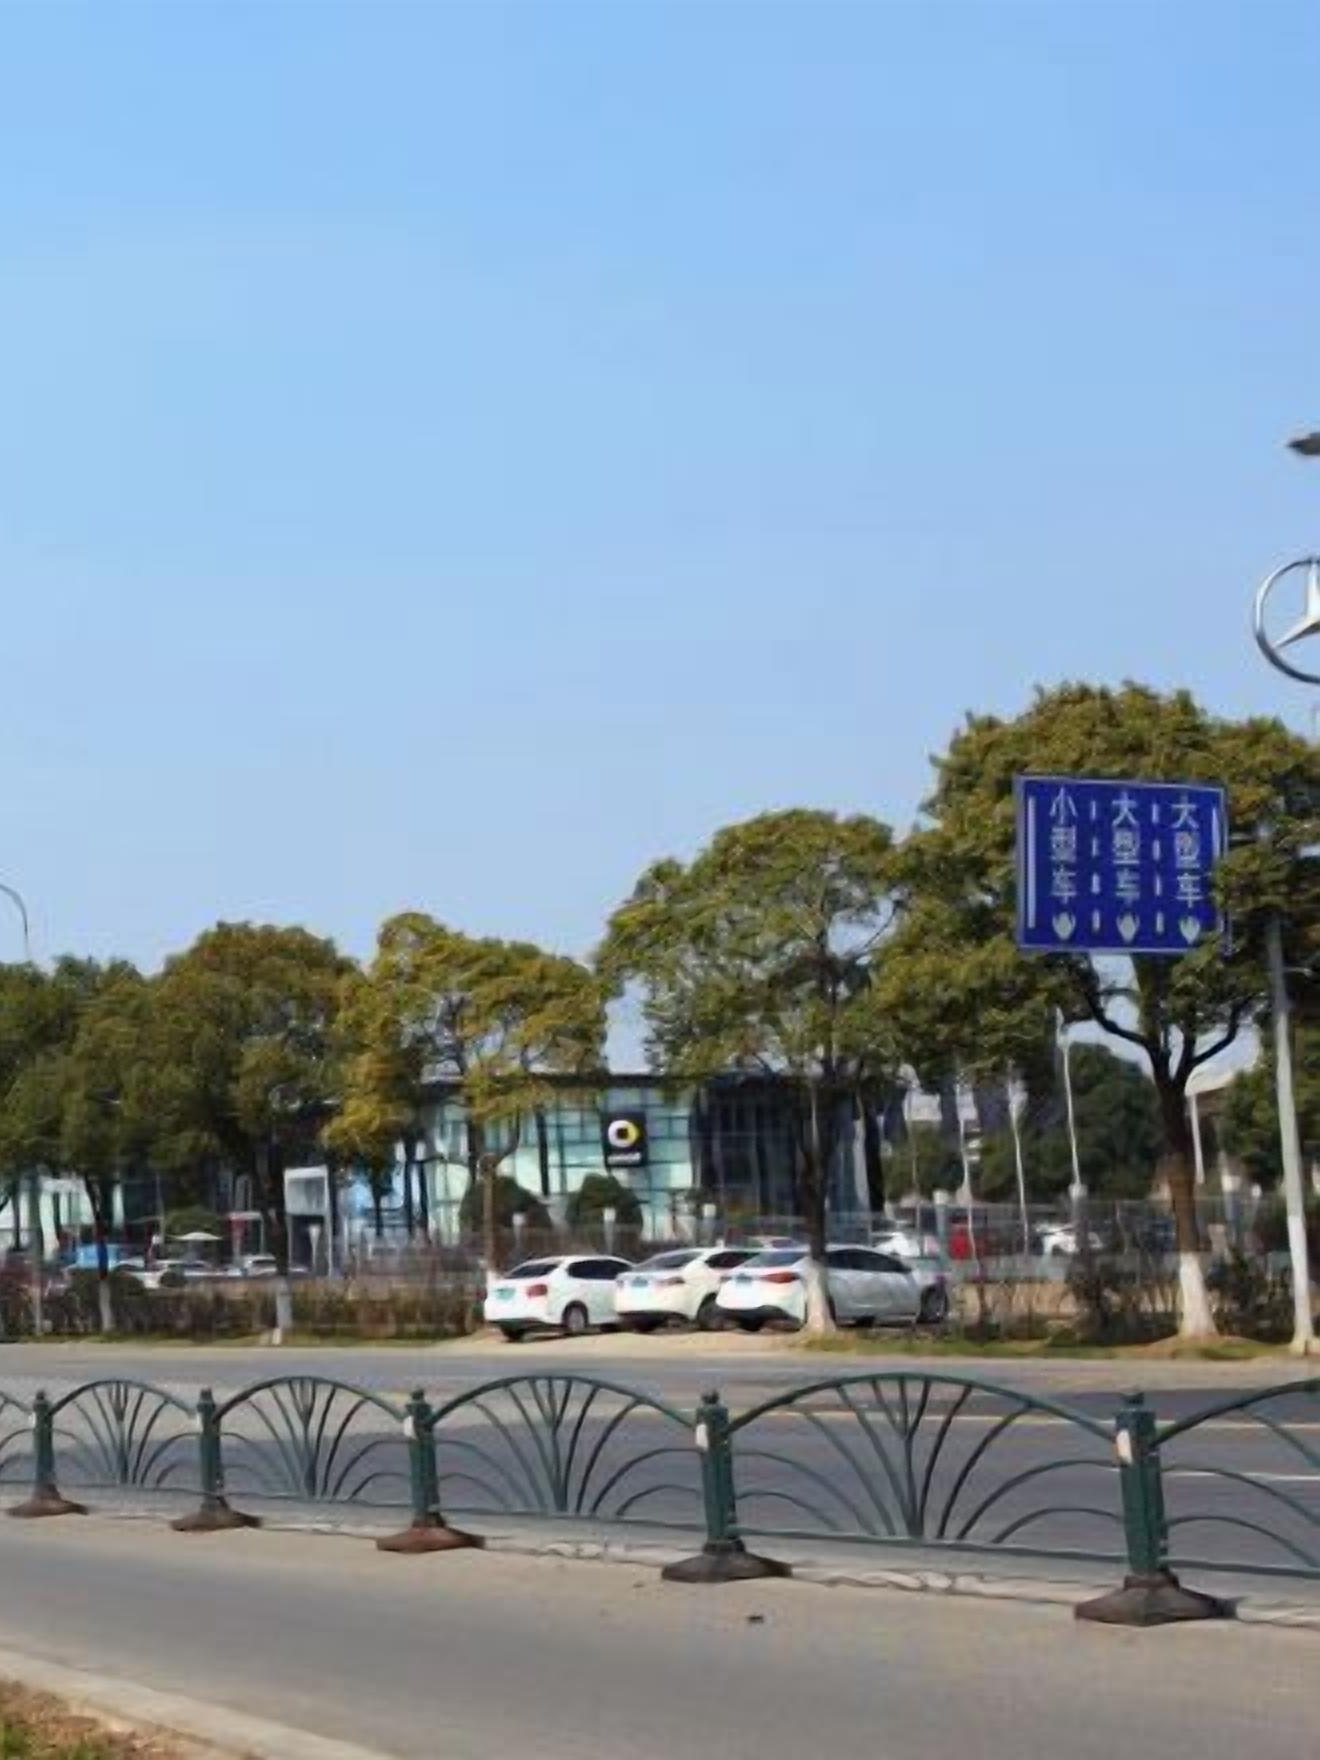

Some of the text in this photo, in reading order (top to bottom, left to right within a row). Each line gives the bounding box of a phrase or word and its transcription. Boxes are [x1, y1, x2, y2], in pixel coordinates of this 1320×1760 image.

[1111, 790, 1141, 904] 大型车
[1170, 794, 1204, 909] 大型车
